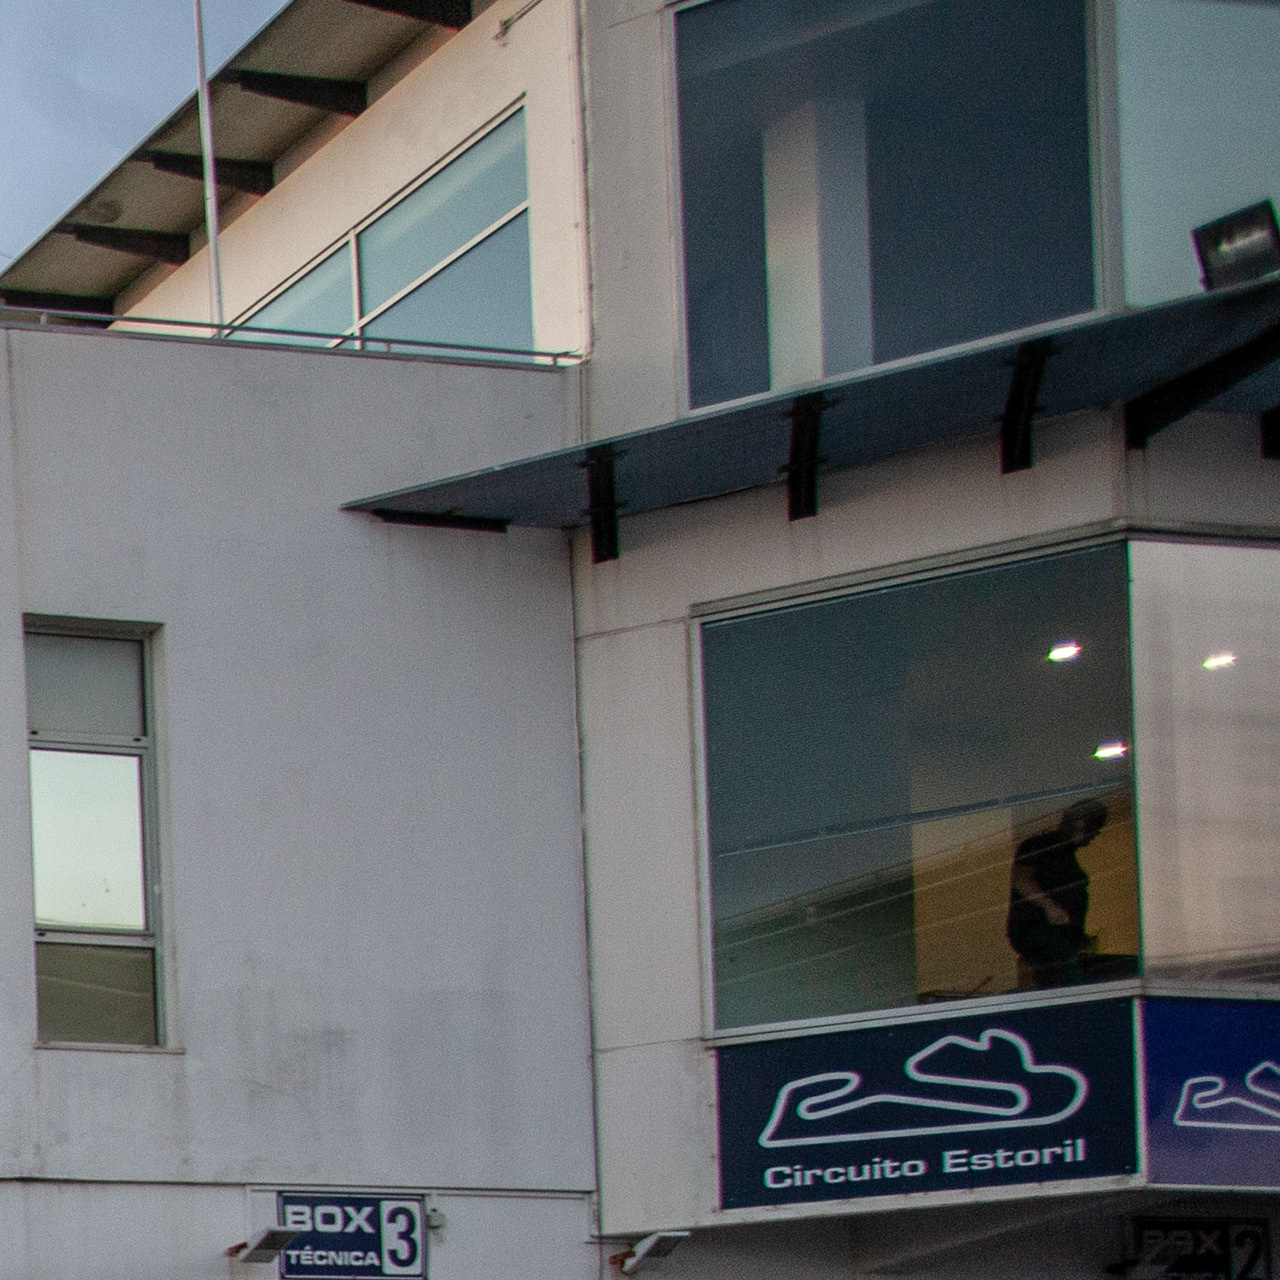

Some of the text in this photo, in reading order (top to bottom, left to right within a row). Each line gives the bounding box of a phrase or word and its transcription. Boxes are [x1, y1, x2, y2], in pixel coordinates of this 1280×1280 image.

[764, 1138, 1087, 1189] Circuito Estoril
[284, 1204, 417, 1268] BOX 3
[286, 1245, 381, 1267] TÉCNICA
